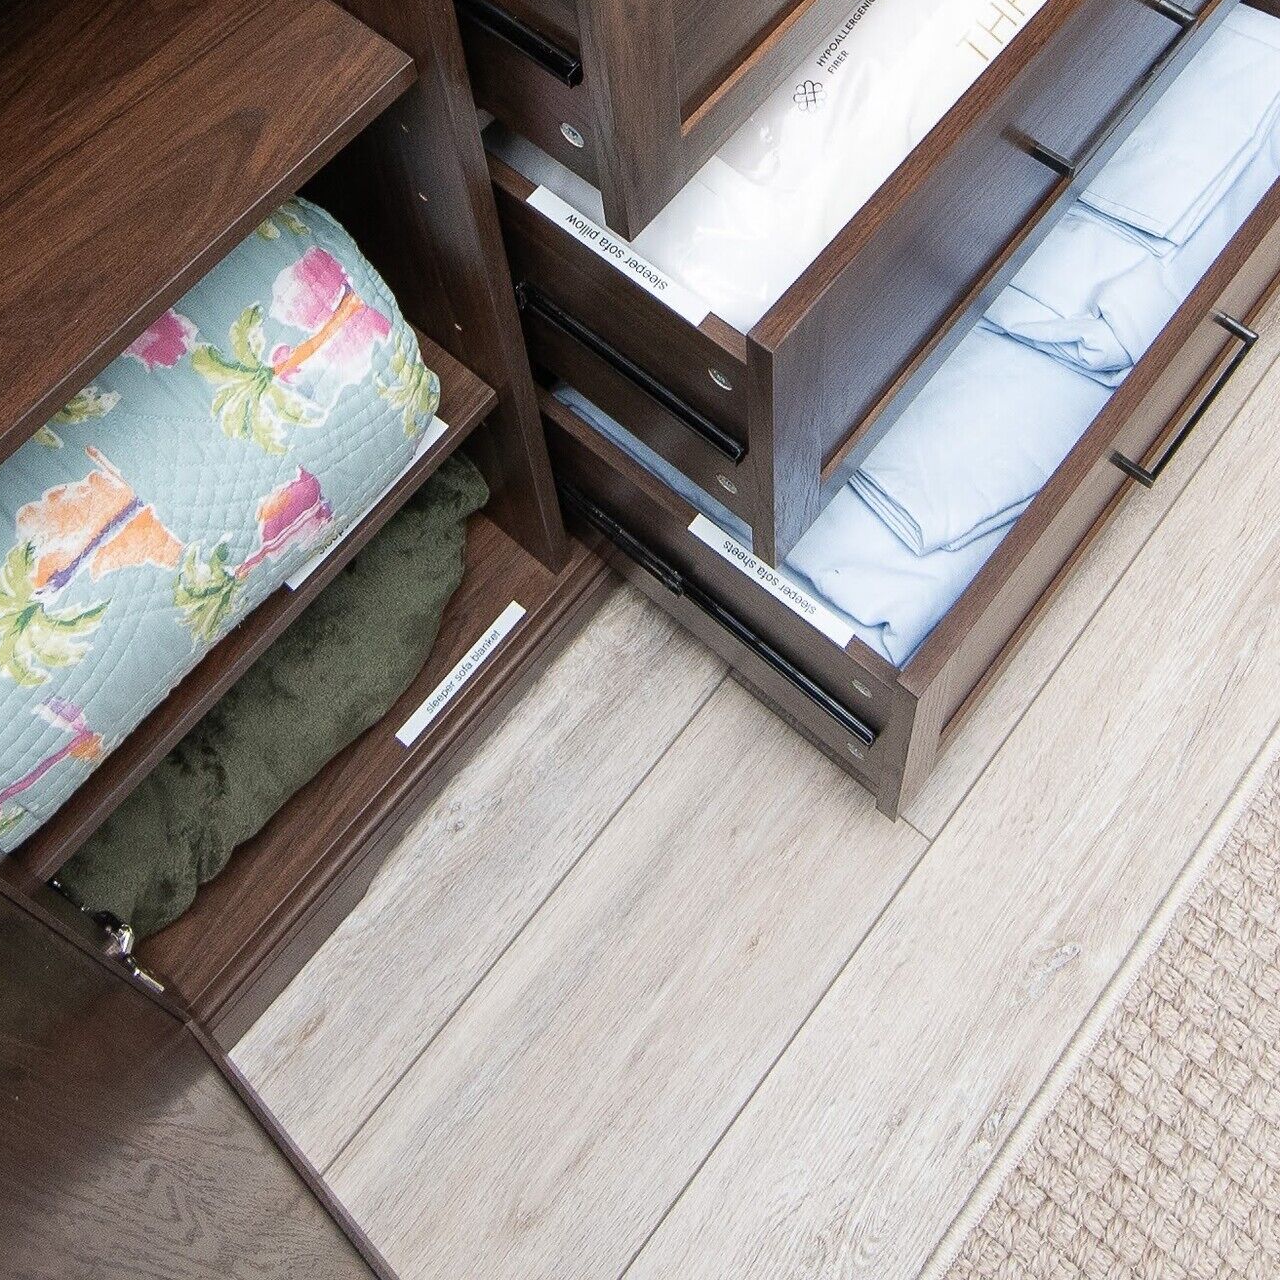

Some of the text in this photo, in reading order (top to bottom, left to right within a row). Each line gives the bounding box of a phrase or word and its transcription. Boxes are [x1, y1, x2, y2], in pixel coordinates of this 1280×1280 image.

[827, 50, 849, 74] FIBER
[566, 214, 668, 291] sleeper sofa pillow
[723, 540, 817, 615] sleeper sofa sheets
[426, 629, 502, 715] sleeper sofa blanket
